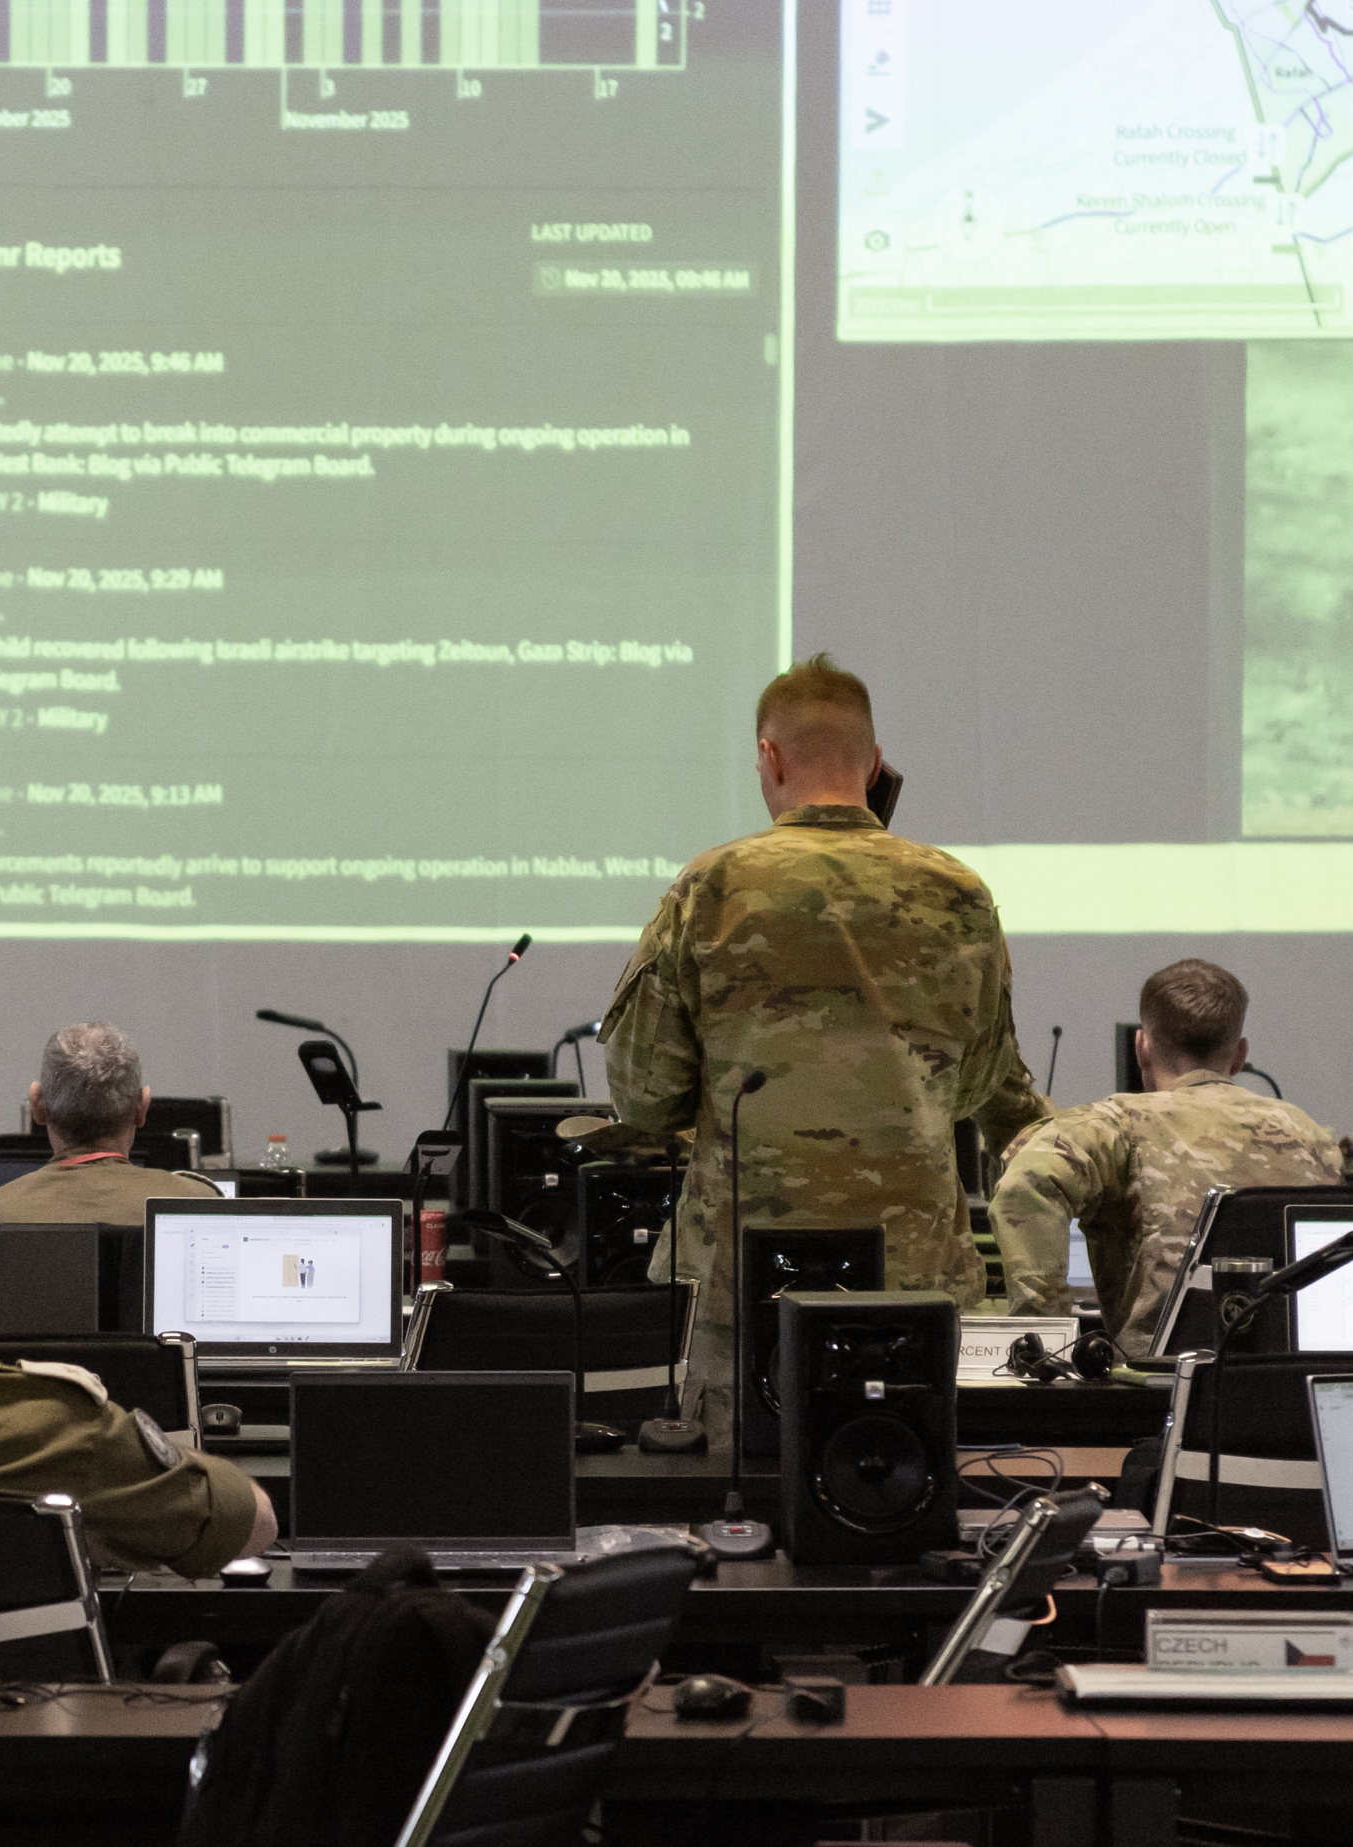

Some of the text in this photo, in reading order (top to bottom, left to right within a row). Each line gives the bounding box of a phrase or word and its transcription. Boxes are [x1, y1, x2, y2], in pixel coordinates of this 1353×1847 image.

[187, 76, 209, 97] 27
[31, 107, 72, 128] 2025
[285, 109, 410, 130] November 2025
[1115, 123, 1237, 143] Rafah Crossing
[1113, 149, 1247, 169] Currently Closed
[1076, 192, 1267, 212] Kerem Shalom Crossing
[532, 223, 652, 242] LAST UPDATED
[1115, 218, 1237, 237] Currently Open
[26, 242, 121, 273] Reports
[565, 270, 597, 288] Nov
[629, 270, 674, 291] 2025,
[723, 271, 749, 288] AM
[27, 352, 65, 372] Nov
[67, 352, 96, 376] 20,
[98, 351, 149, 375] 2025,
[193, 353, 224, 372] AM
[44, 423, 118, 447] attempt
[120, 424, 141, 444] to
[143, 422, 196, 444] break
[198, 423, 237, 444] into
[239, 423, 349, 445] commercial
[351, 425, 432, 449] property
[434, 423, 496, 450] during
[498, 424, 575, 451] ongoing
[576, 425, 668, 449] operation
[670, 425, 690, 445] in
[87, 454, 132, 481] Blog
[133, 454, 162, 476] via
[164, 453, 223, 476] Public
[226, 454, 311, 481] Telegram
[313, 455, 375, 477] Board.
[11, 492, 24, 512] 2
[127, 638, 214, 664] following
[352, 640, 436, 666] targeting
[517, 640, 563, 662] Gaza
[619, 641, 662, 667] Blog
[664, 641, 693, 663] via
[60, 669, 121, 691] Board.
[87, 855, 183, 879] reportedly
[185, 855, 238, 876] arrive
[241, 857, 262, 876] to
[264, 858, 337, 879] support
[340, 856, 416, 881] ongoing
[418, 857, 508, 880] operation
[510, 857, 529, 876] in
[532, 857, 602, 878] Nablus,
[605, 857, 650, 876] West
[958, 1345, 1001, 1356] RCENT
[1157, 1638, 1228, 1653] CZECH
